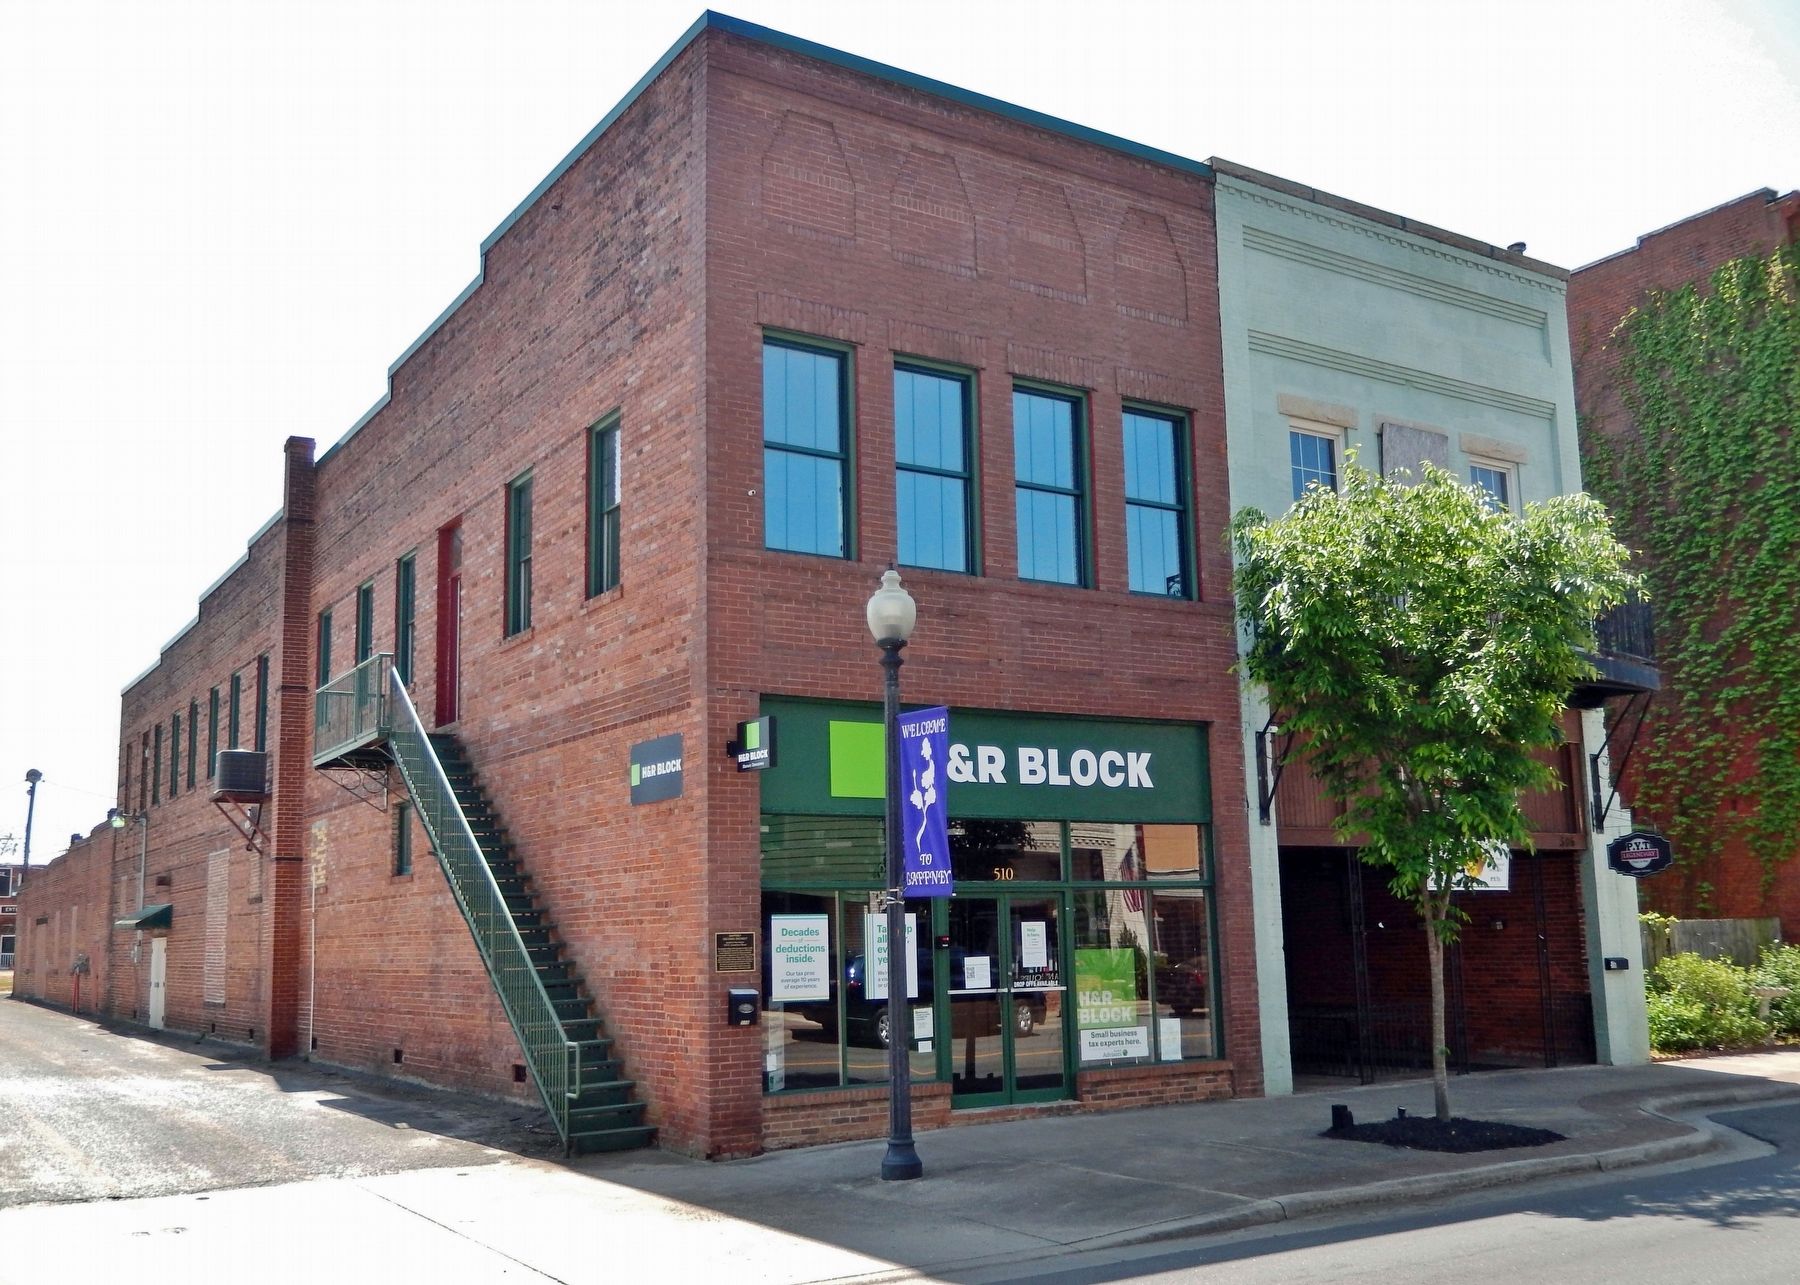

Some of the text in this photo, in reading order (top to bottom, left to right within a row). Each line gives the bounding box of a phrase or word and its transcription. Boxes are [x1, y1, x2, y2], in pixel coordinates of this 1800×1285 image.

[902, 718, 947, 739] WELCOME
[738, 749, 769, 763] H&R BLOCK
[642, 759, 682, 779] H&R BLOCK
[946, 743, 1154, 788] &R BLOCK
[919, 853, 933, 866] TO
[906, 870, 952, 886] GAFFNEY
[993, 867, 1014, 881] 510
[781, 928, 820, 937] Decades
[775, 944, 826, 953] deductions
[786, 954, 816, 963] inside.
[1078, 990, 1113, 1008] H&R
[1078, 1006, 1132, 1025] BLOCK
[1090, 1029, 1138, 1039] Small business
[1099, 1040, 1125, 1048] experts
[1125, 1037, 1142, 1046] here.
